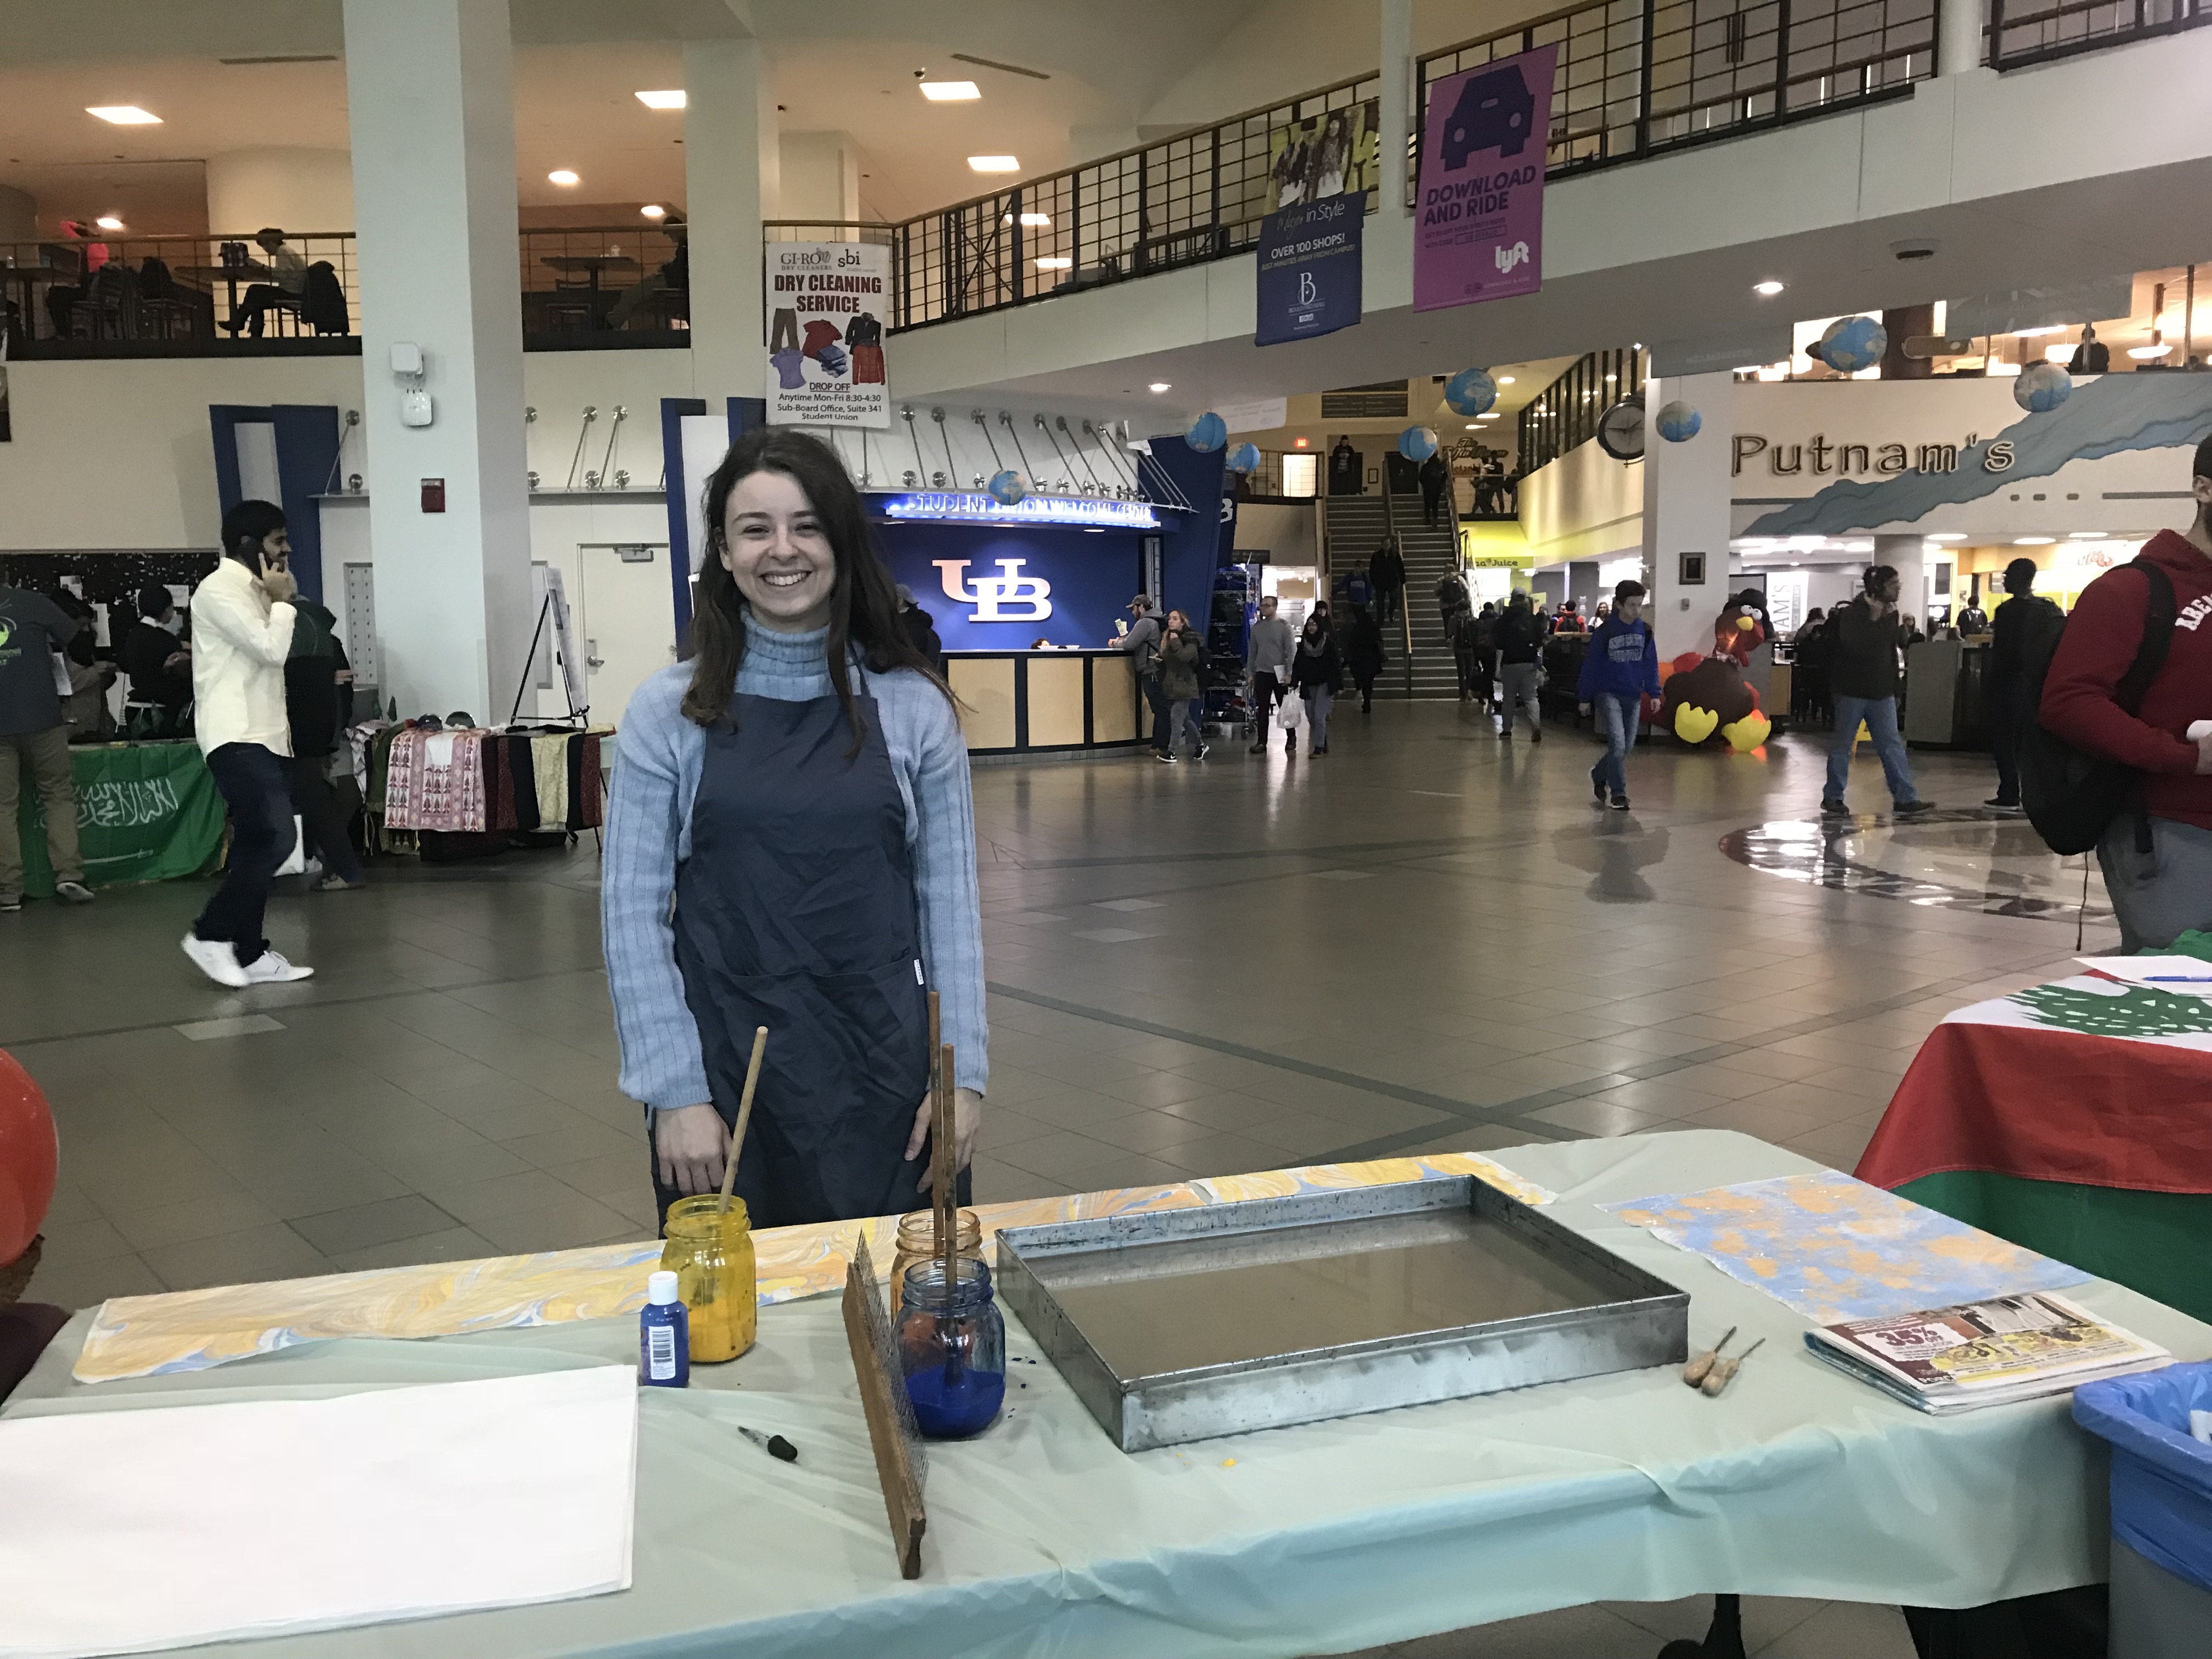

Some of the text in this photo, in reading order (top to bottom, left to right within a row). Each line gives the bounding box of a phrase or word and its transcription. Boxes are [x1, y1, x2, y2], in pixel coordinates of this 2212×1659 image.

[1426, 165, 1536, 206] DOWNLOAD
[1305, 208, 1316, 223] in
[1317, 200, 1345, 222] Style
[1424, 192, 1509, 227] AND RIDE
[1271, 233, 1345, 259] OVER 100 SHOPS!
[781, 252, 821, 265] GI-RO
[838, 249, 861, 267] sbi
[1495, 241, 1530, 274] lyft
[774, 274, 882, 294] DRY CLEANING
[796, 295, 860, 313] SERVICE
[809, 382, 850, 391] DROP OFF
[778, 393, 812, 402] Anytime
[814, 393, 844, 402] Mon-Fri
[777, 404, 819, 412] Sub-Board
[820, 404, 845, 413] Office,
[1733, 432, 2015, 476] Putnam's
[907, 494, 988, 513] STUDENT
[932, 558, 1052, 622] UB
[1875, 1327, 1938, 1346] 35%
